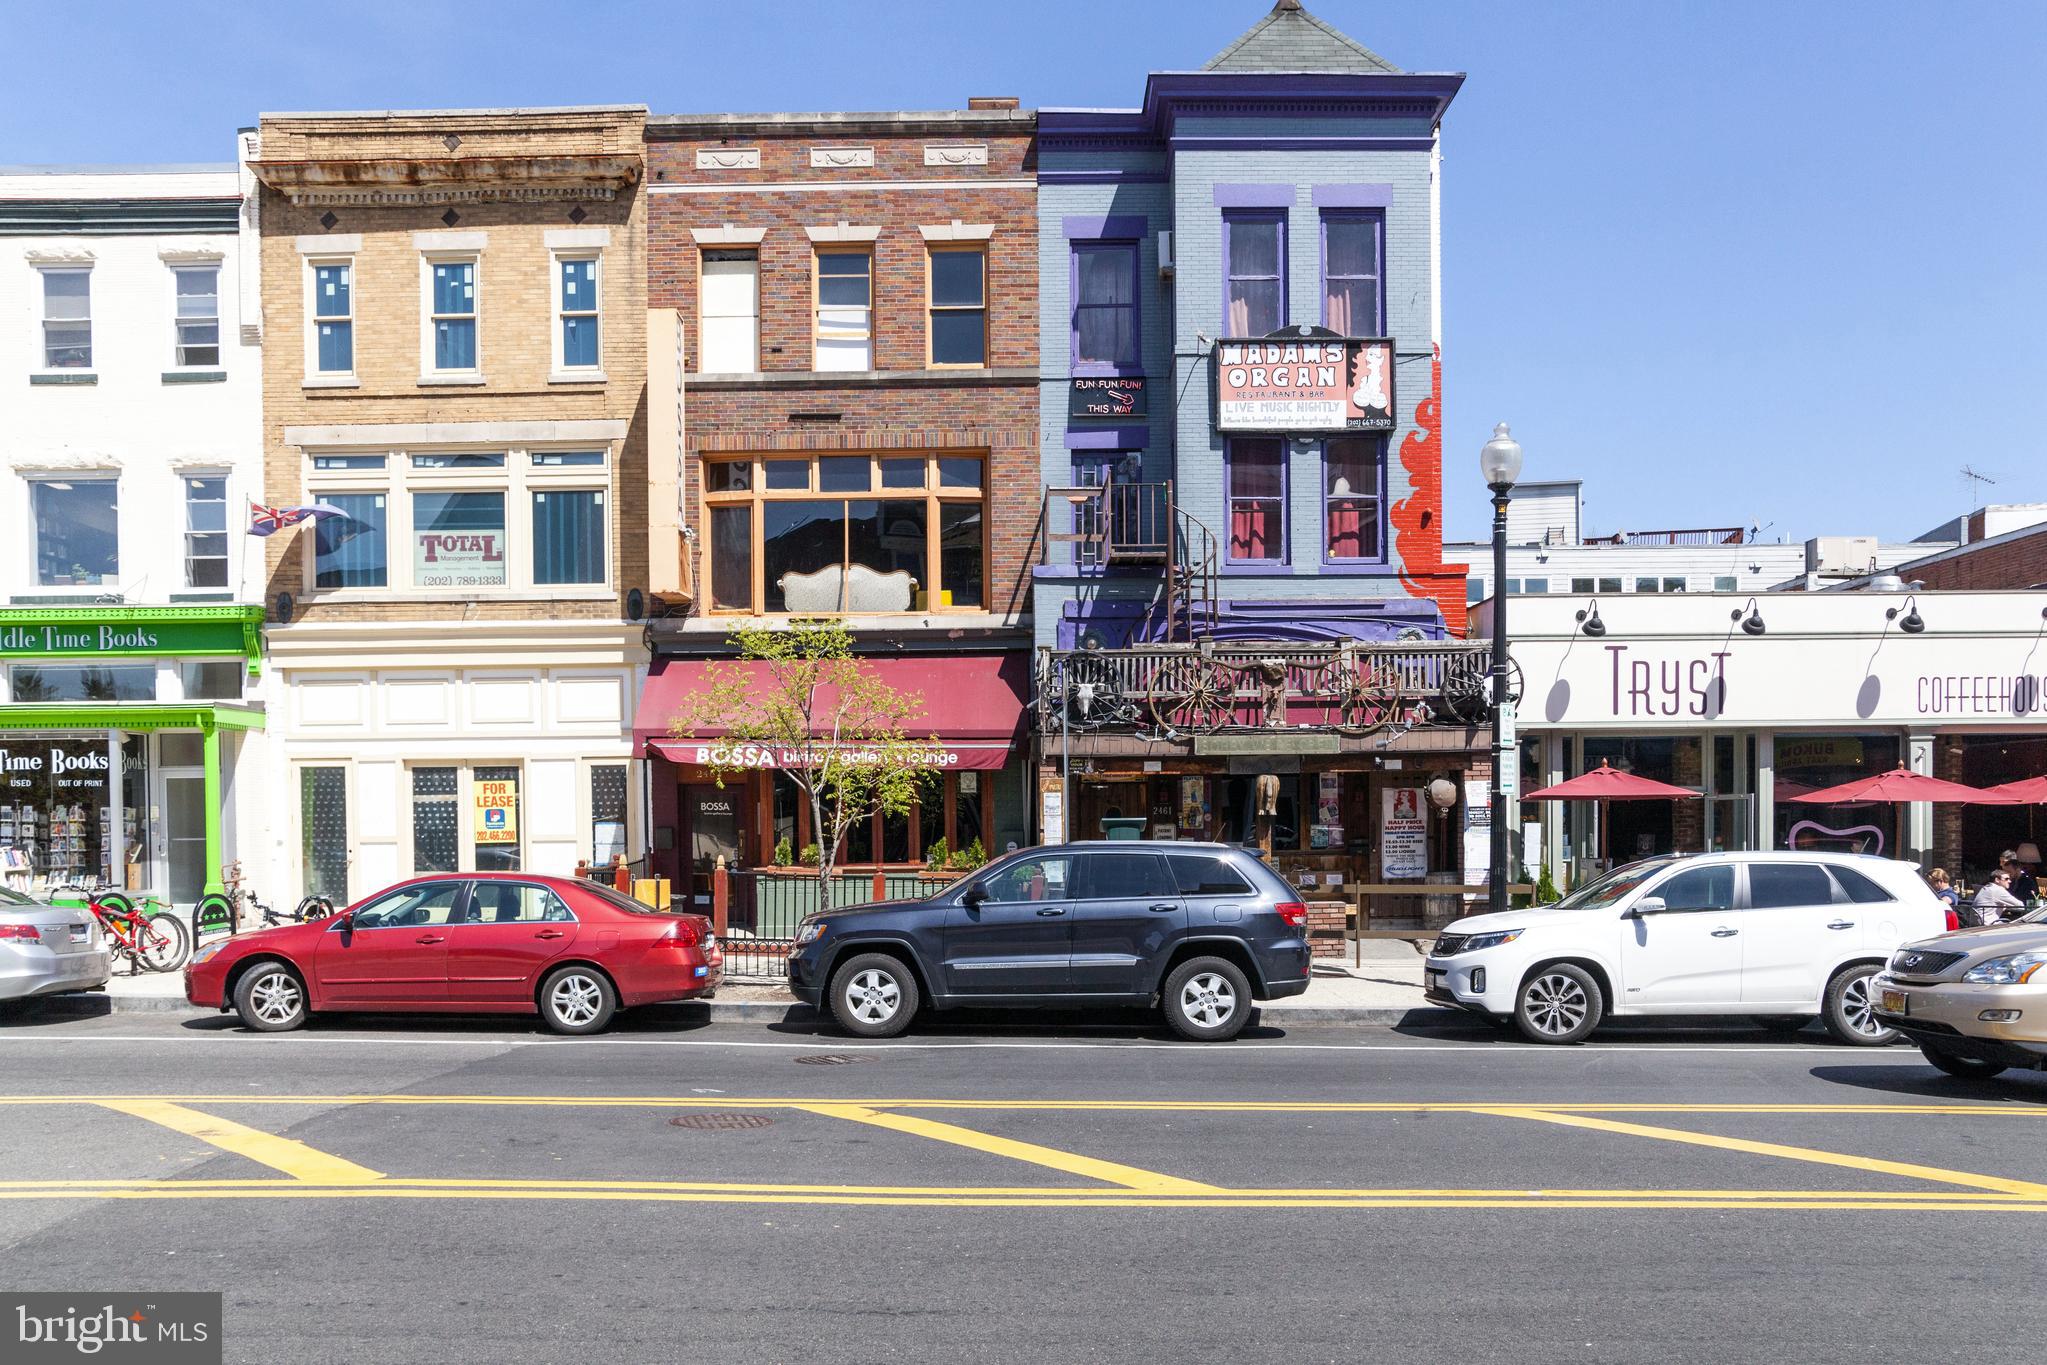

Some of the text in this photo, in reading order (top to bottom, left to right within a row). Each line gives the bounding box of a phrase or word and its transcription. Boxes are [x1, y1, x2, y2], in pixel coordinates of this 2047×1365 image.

[1220, 343, 1344, 366] MADAM'S
[1227, 366, 1336, 389] ORGAN
[1075, 380, 1142, 390] FUN FUN FUN!
[1236, 390, 1296, 398] RESTAURANT
[1088, 404, 1132, 414] THIS WAY
[1225, 402, 1340, 413] LIVE MUSIC NIGHTLY
[419, 534, 503, 562] TOTAL
[440, 555, 480, 563] Management
[424, 576, 502, 586] (202) 789-1333
[41, 626, 91, 650] Time
[98, 625, 157, 650] Books
[1604, 645, 1732, 716] TRYST
[51, 749, 108, 774] Books
[696, 747, 775, 767] BOSSA
[483, 783, 506, 794] FOR
[477, 796, 513, 807] LEASE
[701, 802, 730, 811] BOSSA
